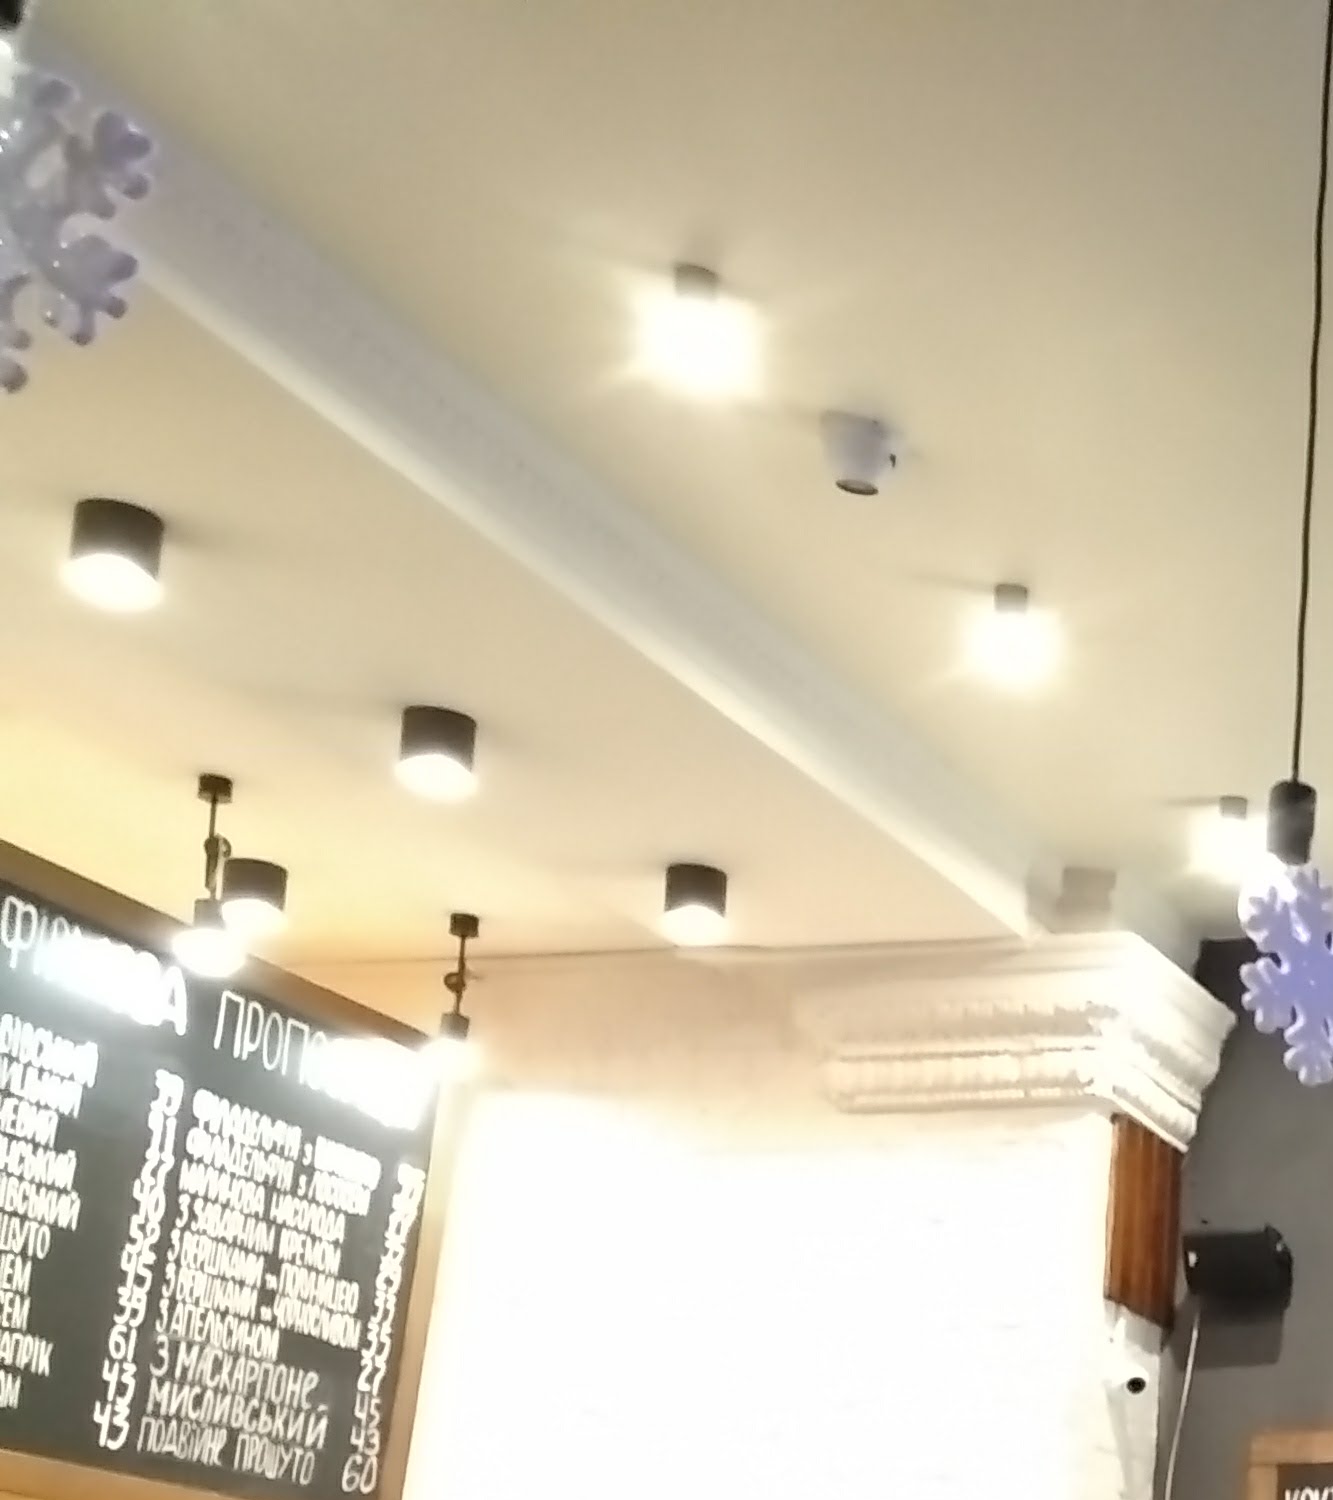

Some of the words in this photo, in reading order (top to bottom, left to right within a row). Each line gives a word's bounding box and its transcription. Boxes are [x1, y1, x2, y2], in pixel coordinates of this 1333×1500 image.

[279, 1228, 341, 1276] КРЕМОМ
[113, 1285, 147, 1327] 39
[109, 1324, 137, 1362] 61
[168, 1302, 281, 1362] АПЕЛЬСИНОМ
[102, 1357, 137, 1403] 43
[93, 1400, 130, 1450] 43
[146, 1377, 329, 1450] МИСЛИВСЬКИЙ
[351, 1425, 380, 1456] 43
[354, 1392, 380, 1429] 45
[233, 1433, 316, 1486] ПРОШУТО
[341, 1454, 379, 1494] 60
